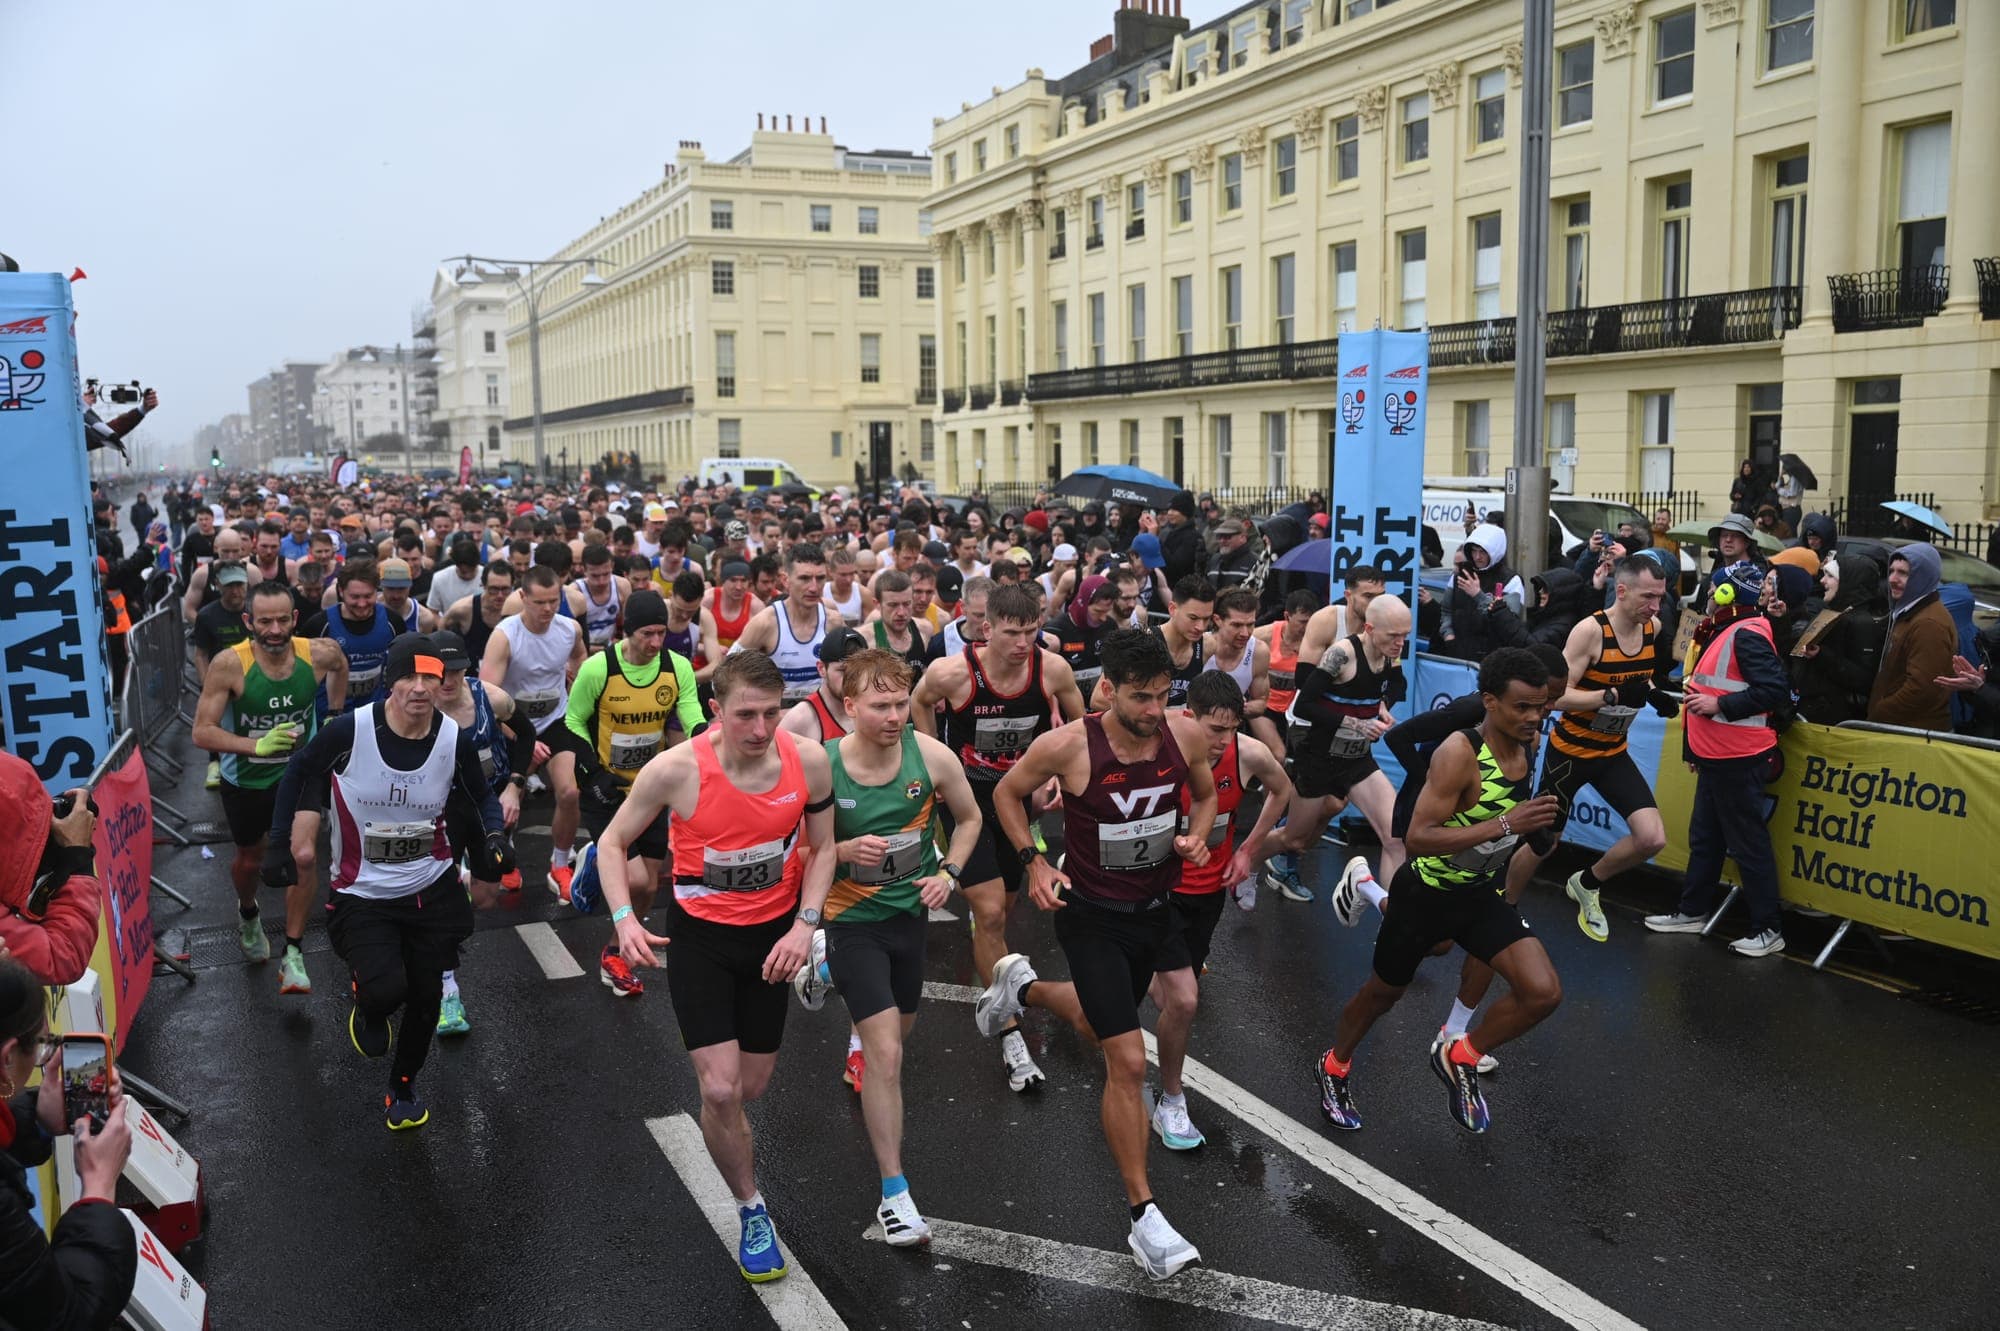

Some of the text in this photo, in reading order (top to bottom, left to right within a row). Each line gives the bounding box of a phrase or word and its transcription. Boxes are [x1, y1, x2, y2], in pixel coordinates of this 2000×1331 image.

[0, 509, 96, 781] START
[240, 704, 313, 731] NSPCC
[974, 705, 1005, 715] BRAT
[995, 732, 1019, 748] 39
[1103, 773, 1127, 784] ACC
[1799, 755, 1967, 818] Brighton
[389, 783, 409, 806] hj
[1110, 783, 1175, 819] VT
[1794, 800, 1875, 849] Half
[381, 838, 423, 858] 139
[1134, 840, 1149, 863] 2
[721, 863, 769, 886] 123
[882, 855, 896, 876] 4
[1790, 845, 1989, 927] Marathon
